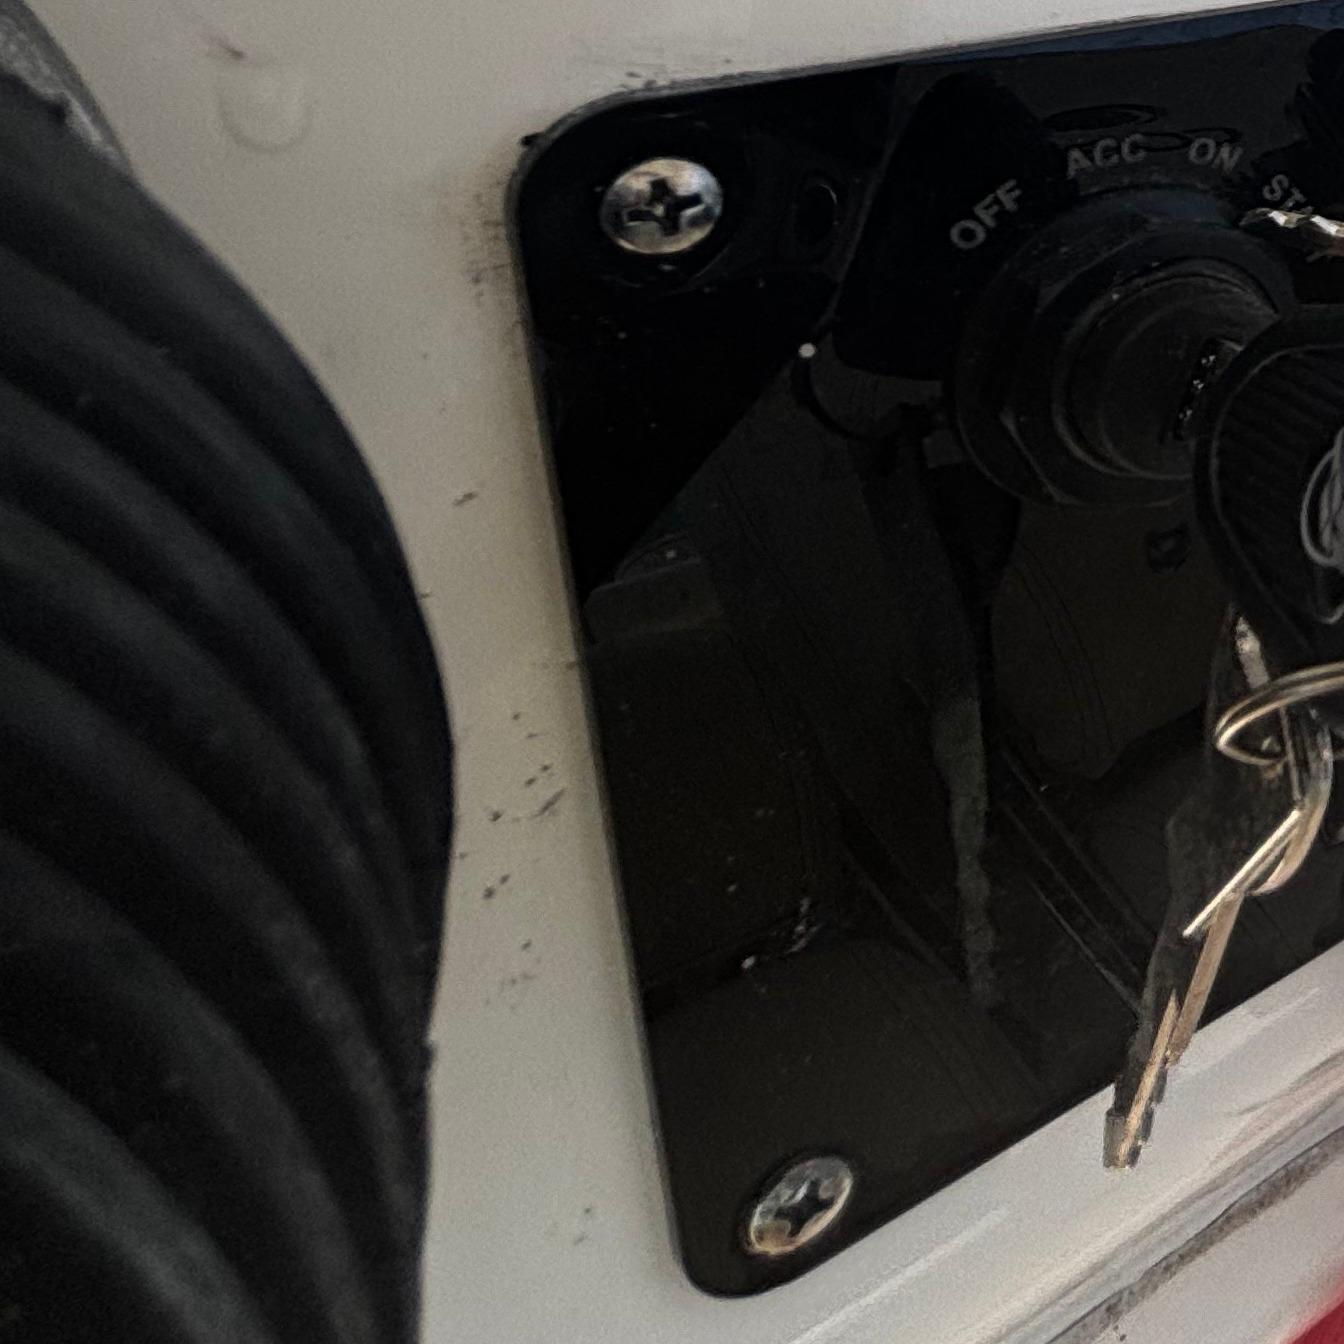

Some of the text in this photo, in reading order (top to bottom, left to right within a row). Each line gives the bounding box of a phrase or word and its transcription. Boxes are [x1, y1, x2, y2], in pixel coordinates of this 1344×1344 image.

[1066, 133, 1146, 179] ACC
[1188, 138, 1244, 175] ON
[950, 179, 1024, 249] OFF
